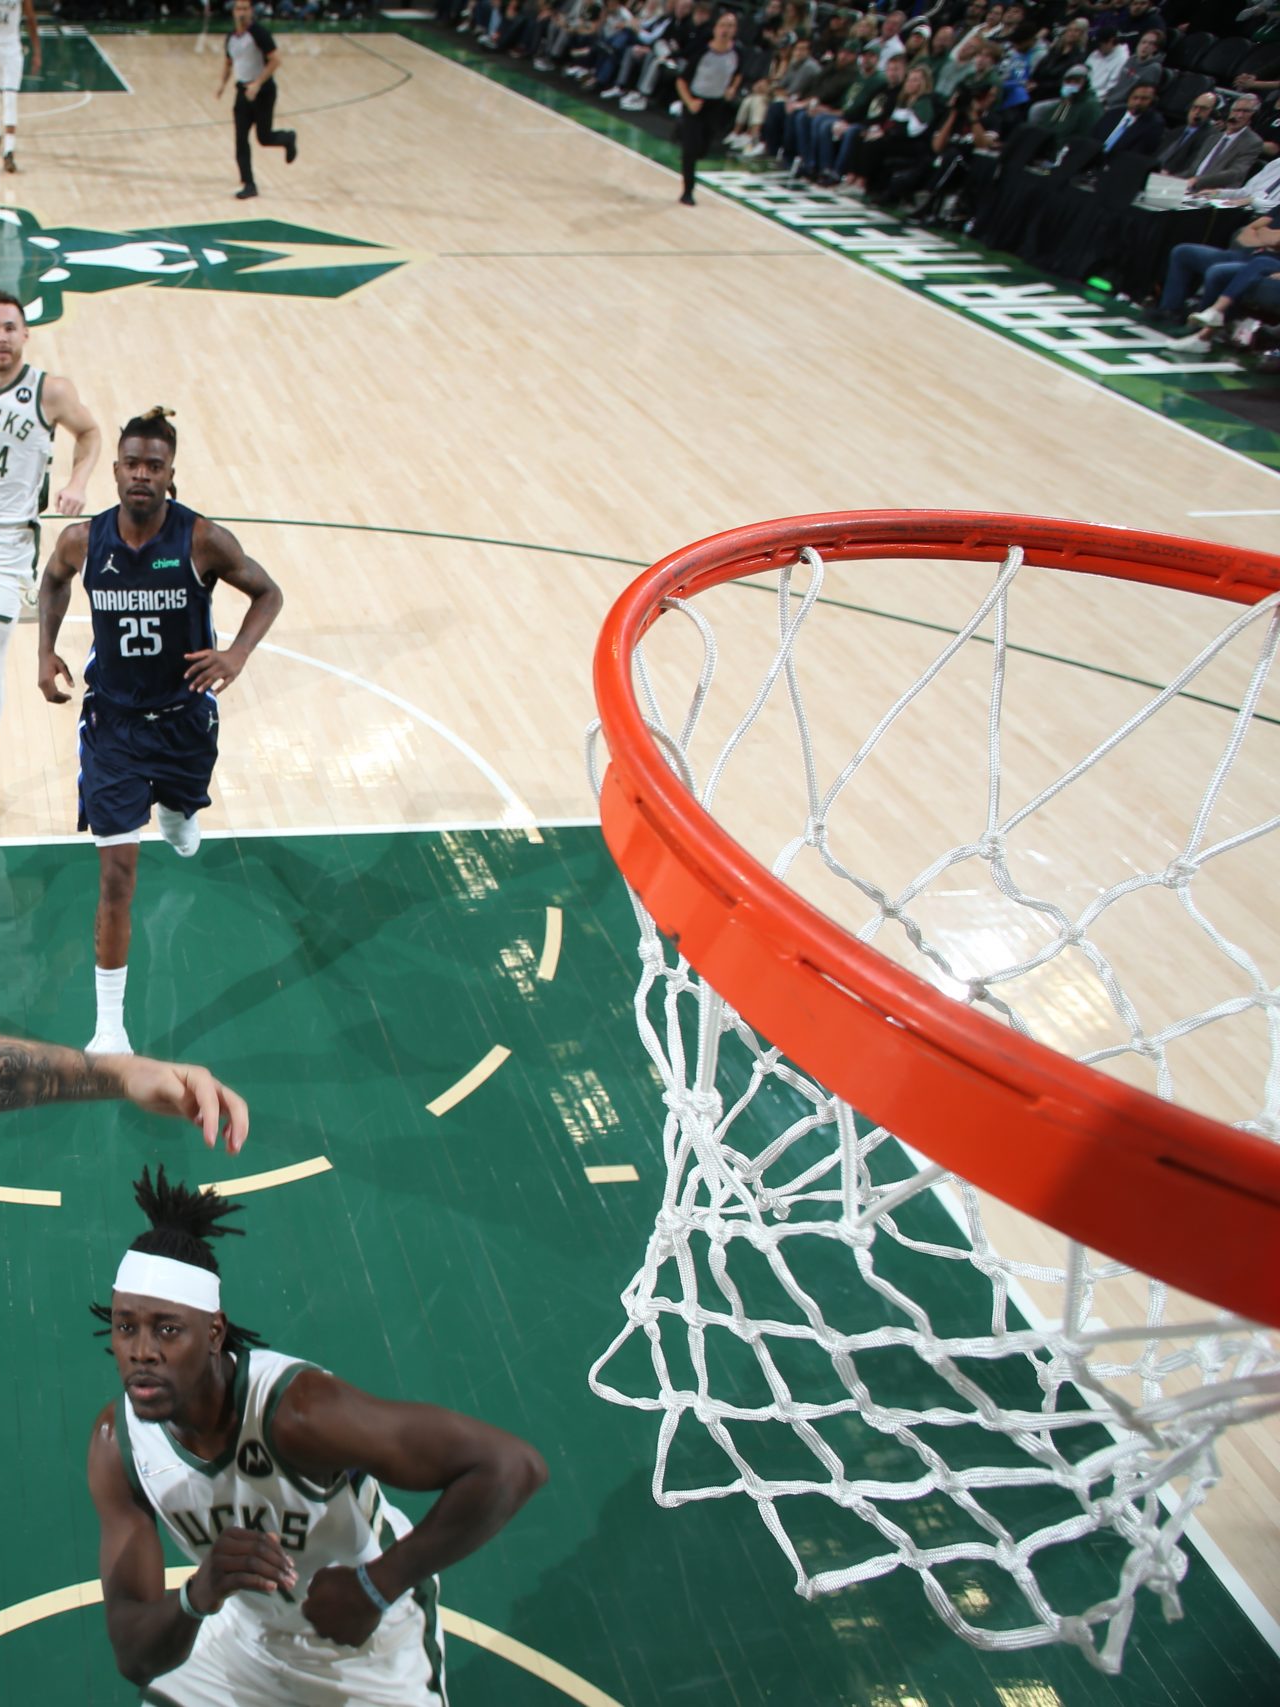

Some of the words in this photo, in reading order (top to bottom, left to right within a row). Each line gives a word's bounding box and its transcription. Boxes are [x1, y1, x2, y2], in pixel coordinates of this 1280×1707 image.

[151, 556, 181, 571] chime
[92, 588, 188, 612] MAVERICKS
[119, 616, 163, 657] 25
[172, 1503, 311, 1553] UCKS
